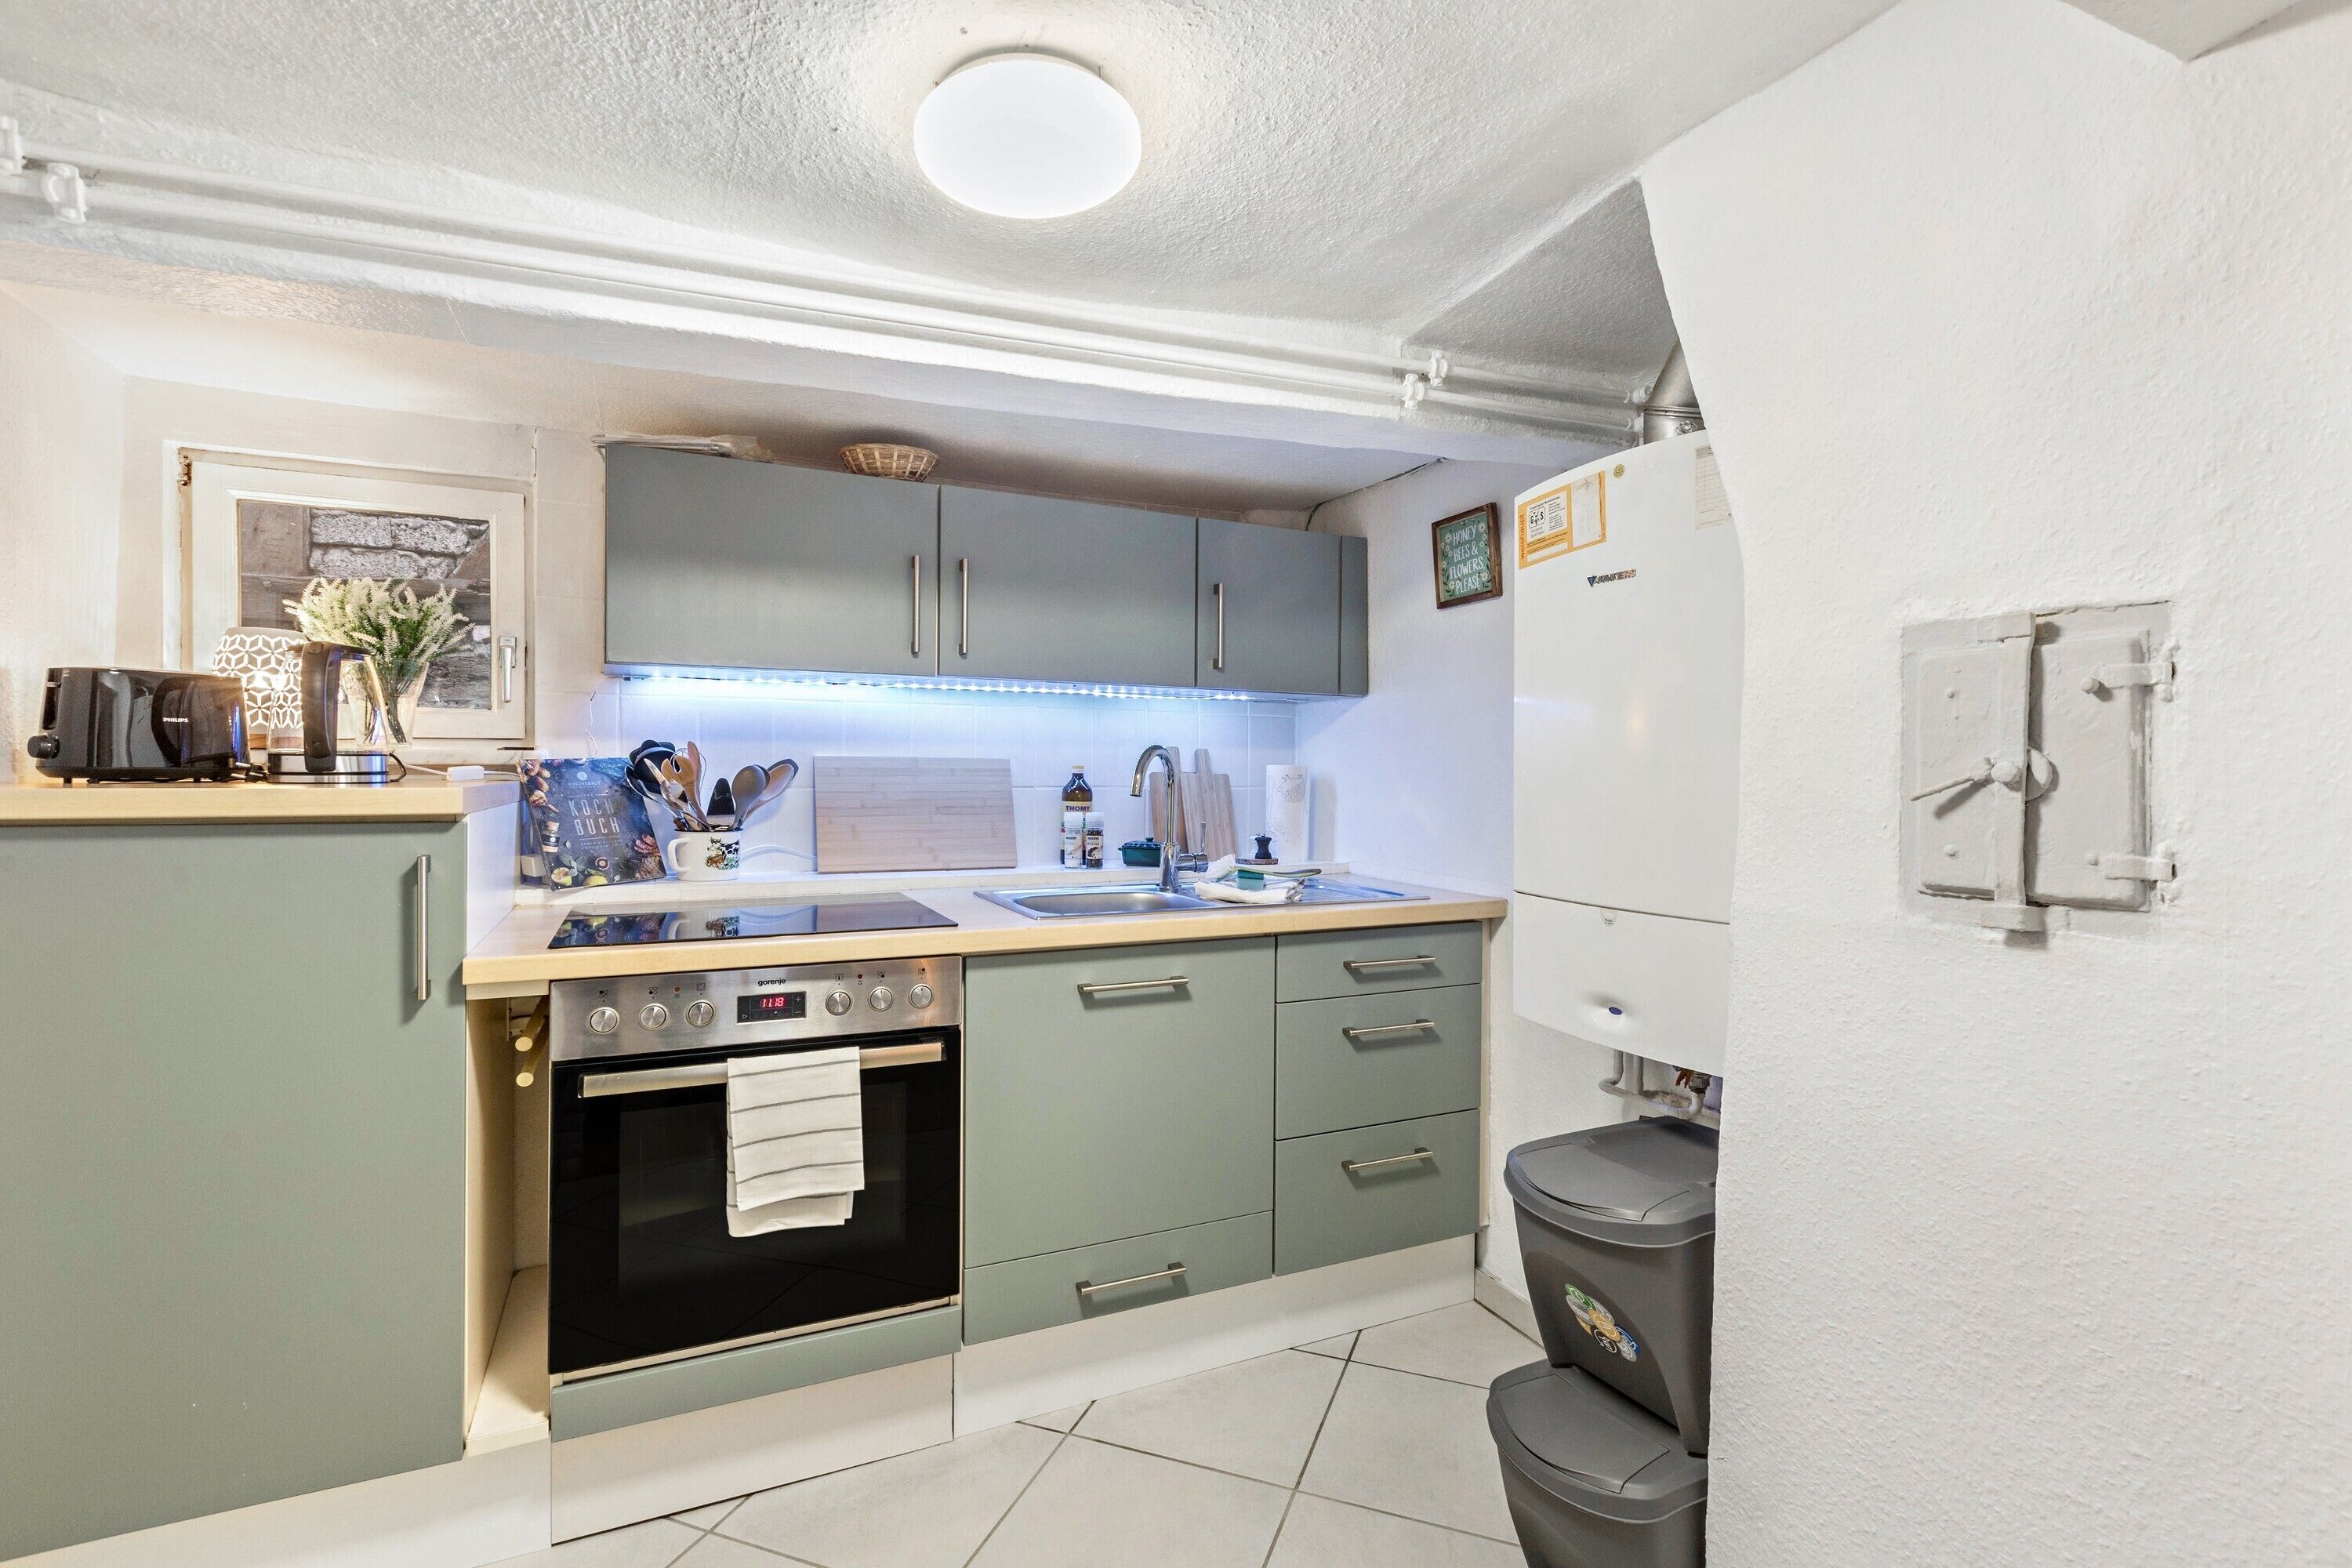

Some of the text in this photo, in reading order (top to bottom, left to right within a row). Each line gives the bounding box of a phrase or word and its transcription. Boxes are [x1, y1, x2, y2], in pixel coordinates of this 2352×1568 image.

[1453, 524, 1477, 546] HONEY
[1454, 541, 1479, 562] BEES &
[1455, 575, 1481, 595] PLEASE
[568, 799, 614, 816] KOCH
[574, 817, 620, 836] BUCH
[757, 977, 786, 986] gorenje
